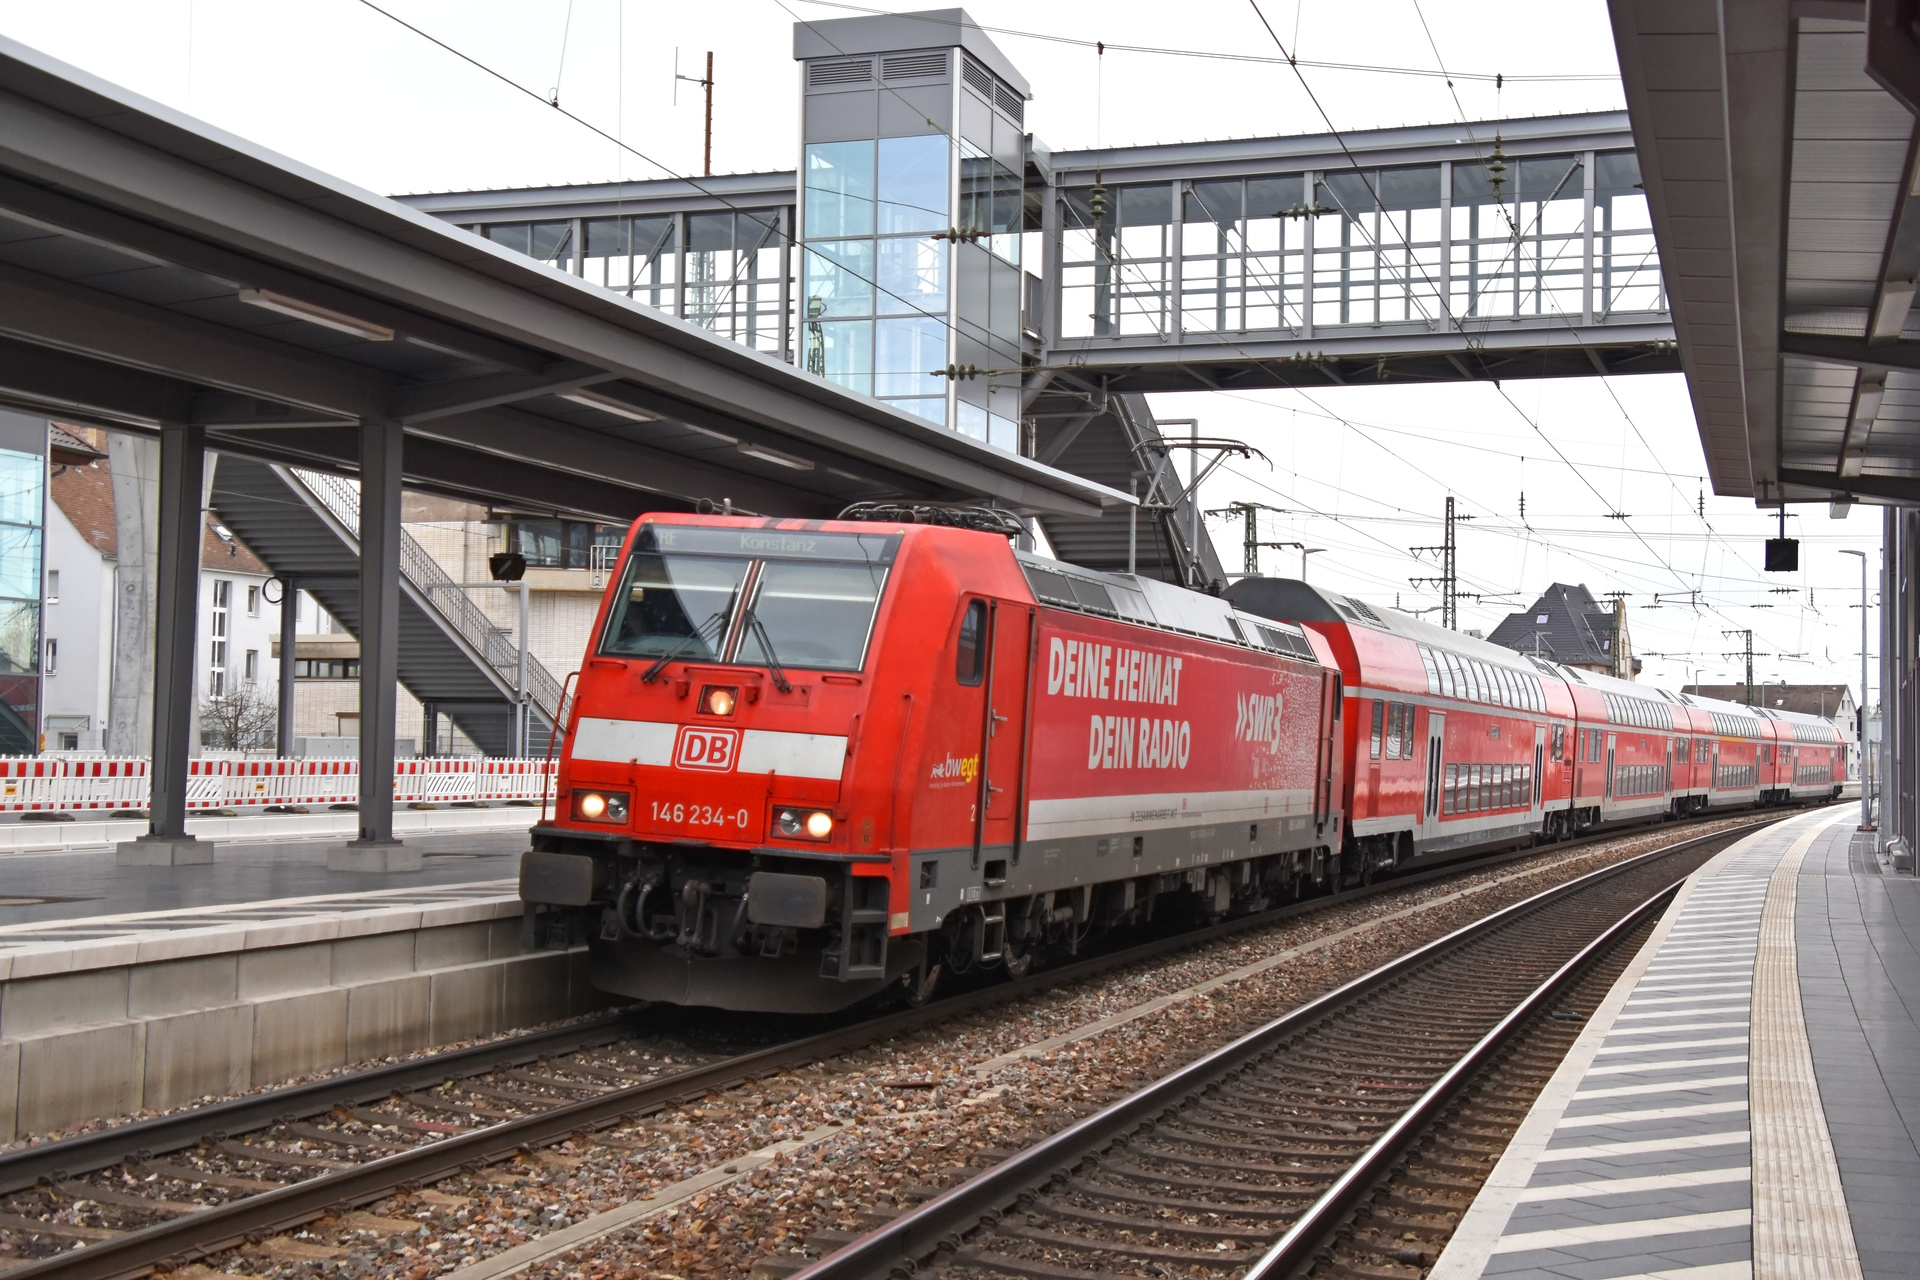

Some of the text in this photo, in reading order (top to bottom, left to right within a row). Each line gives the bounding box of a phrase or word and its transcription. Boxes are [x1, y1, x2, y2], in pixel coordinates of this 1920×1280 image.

[658, 531, 817, 552] RE Konstanz
[1047, 637, 1182, 706] DEINE HEIMAT
[1246, 693, 1283, 755] SWR3
[684, 734, 728, 764] DB
[1088, 715, 1191, 769] DEIN RADIO
[945, 752, 979, 783] bwegt
[651, 801, 748, 828] 146 234-0
[970, 804, 976, 822] 2
